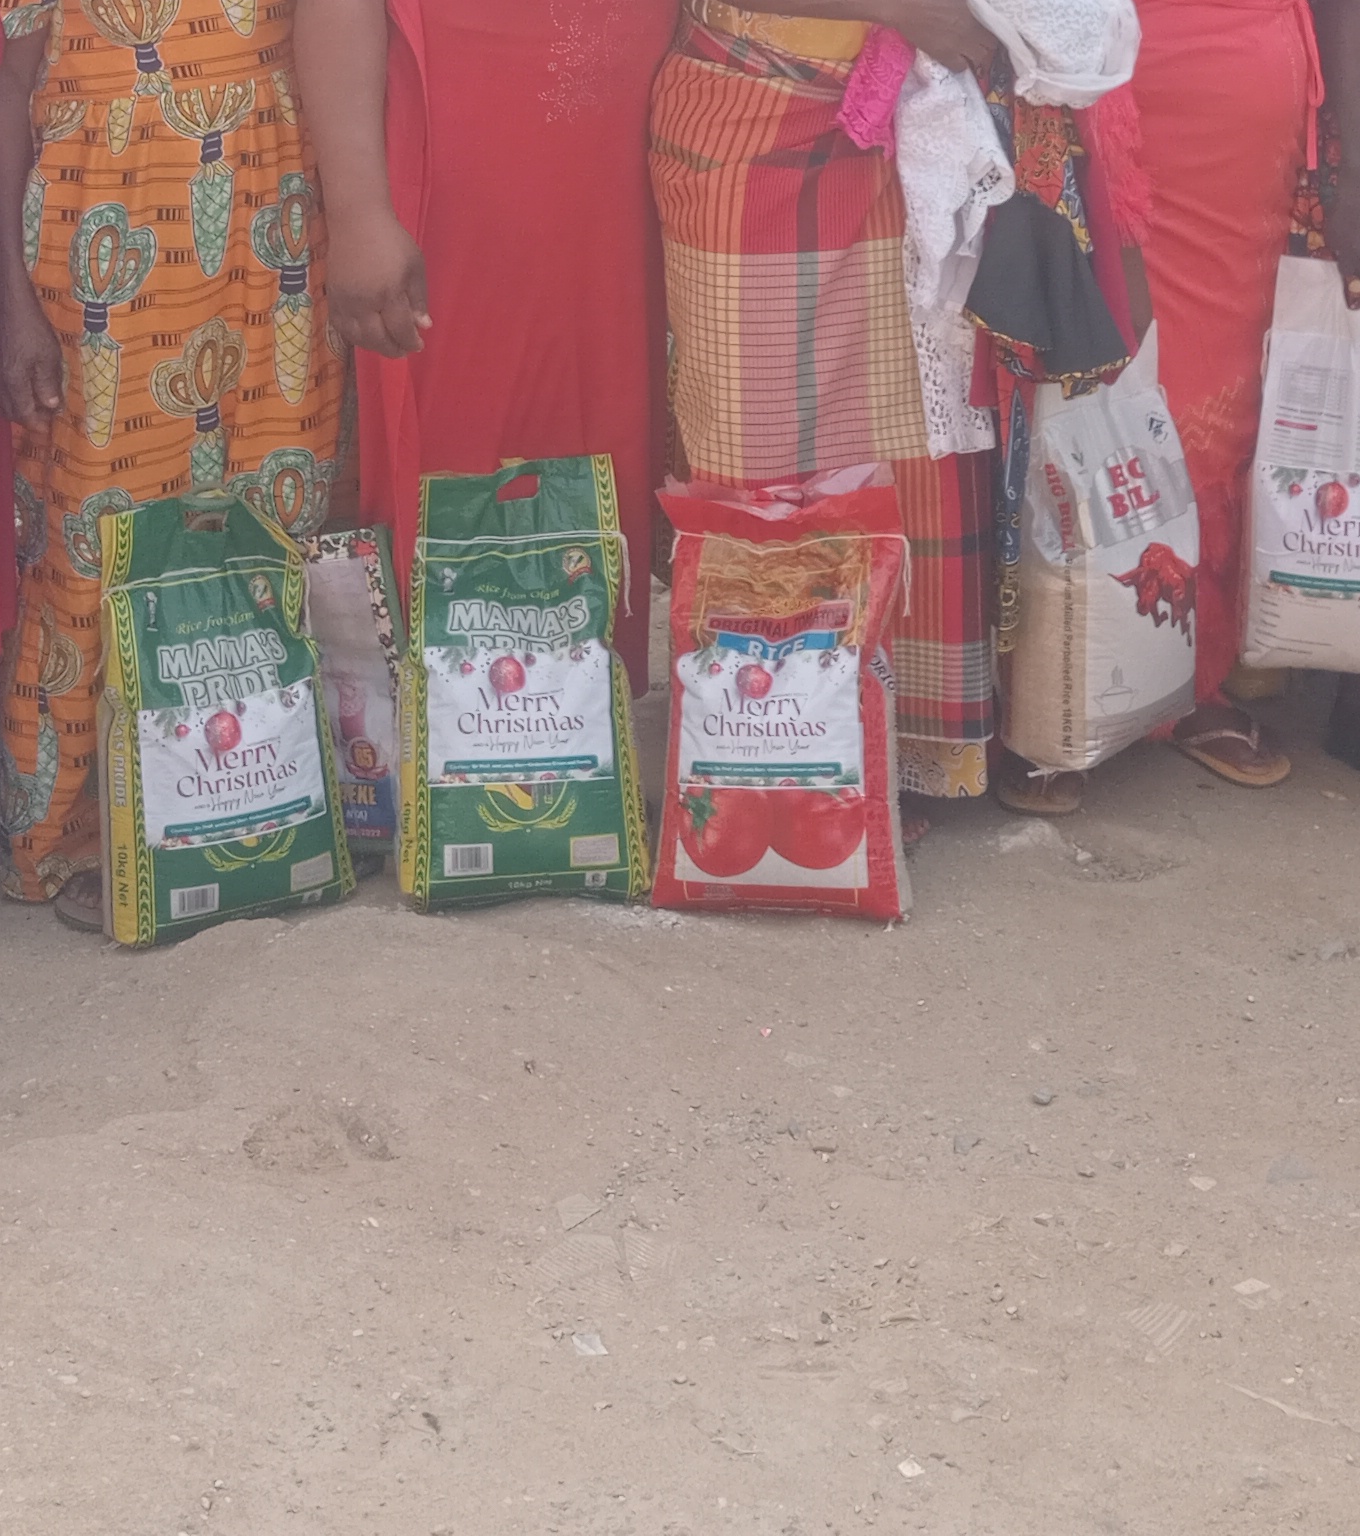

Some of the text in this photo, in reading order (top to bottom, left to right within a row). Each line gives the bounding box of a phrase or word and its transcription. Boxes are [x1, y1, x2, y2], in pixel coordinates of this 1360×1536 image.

[175, 620, 202, 635] Rice
[447, 595, 590, 638] MAMA'S
[708, 616, 789, 637] ORIGINAL
[157, 629, 288, 680] MAMA'S
[747, 638, 805, 660] RICE
[181, 664, 283, 709] PRIDE
[476, 687, 565, 713] Merry
[720, 688, 808, 721] Merry
[457, 712, 585, 735] Christmas
[703, 713, 827, 737] Christmas
[195, 736, 281, 773] Merry
[113, 753, 127, 808] PRIDE
[177, 759, 298, 798] Christmas
[115, 880, 130, 908] Net
